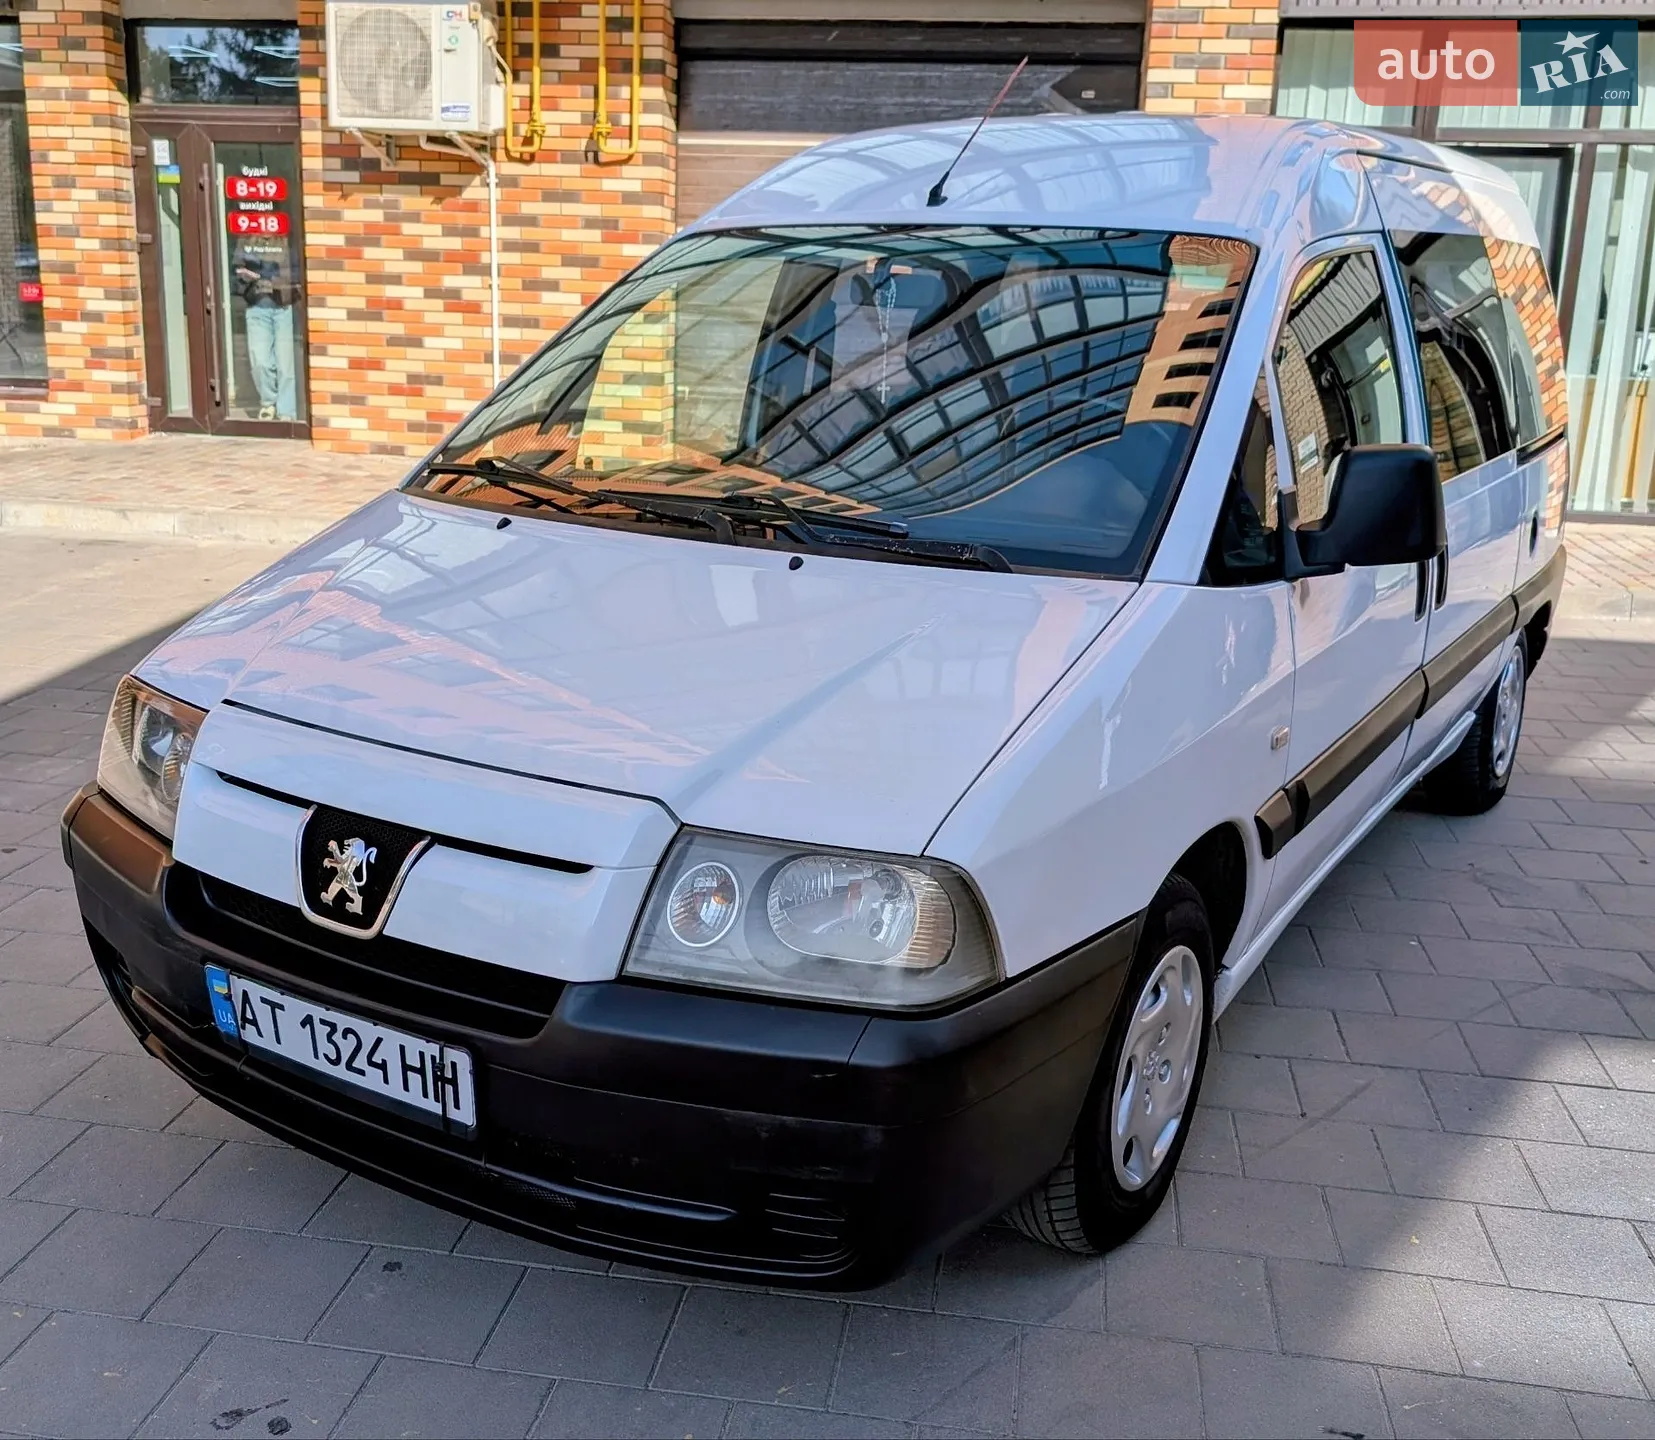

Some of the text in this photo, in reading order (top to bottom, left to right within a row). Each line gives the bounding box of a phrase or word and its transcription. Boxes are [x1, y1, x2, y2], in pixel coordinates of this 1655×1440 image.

[236, 180, 277, 197] 8-19
[237, 215, 279, 232] 9-18
[218, 1009, 237, 1026] UA
[240, 988, 461, 1111] AT 1324 HH
